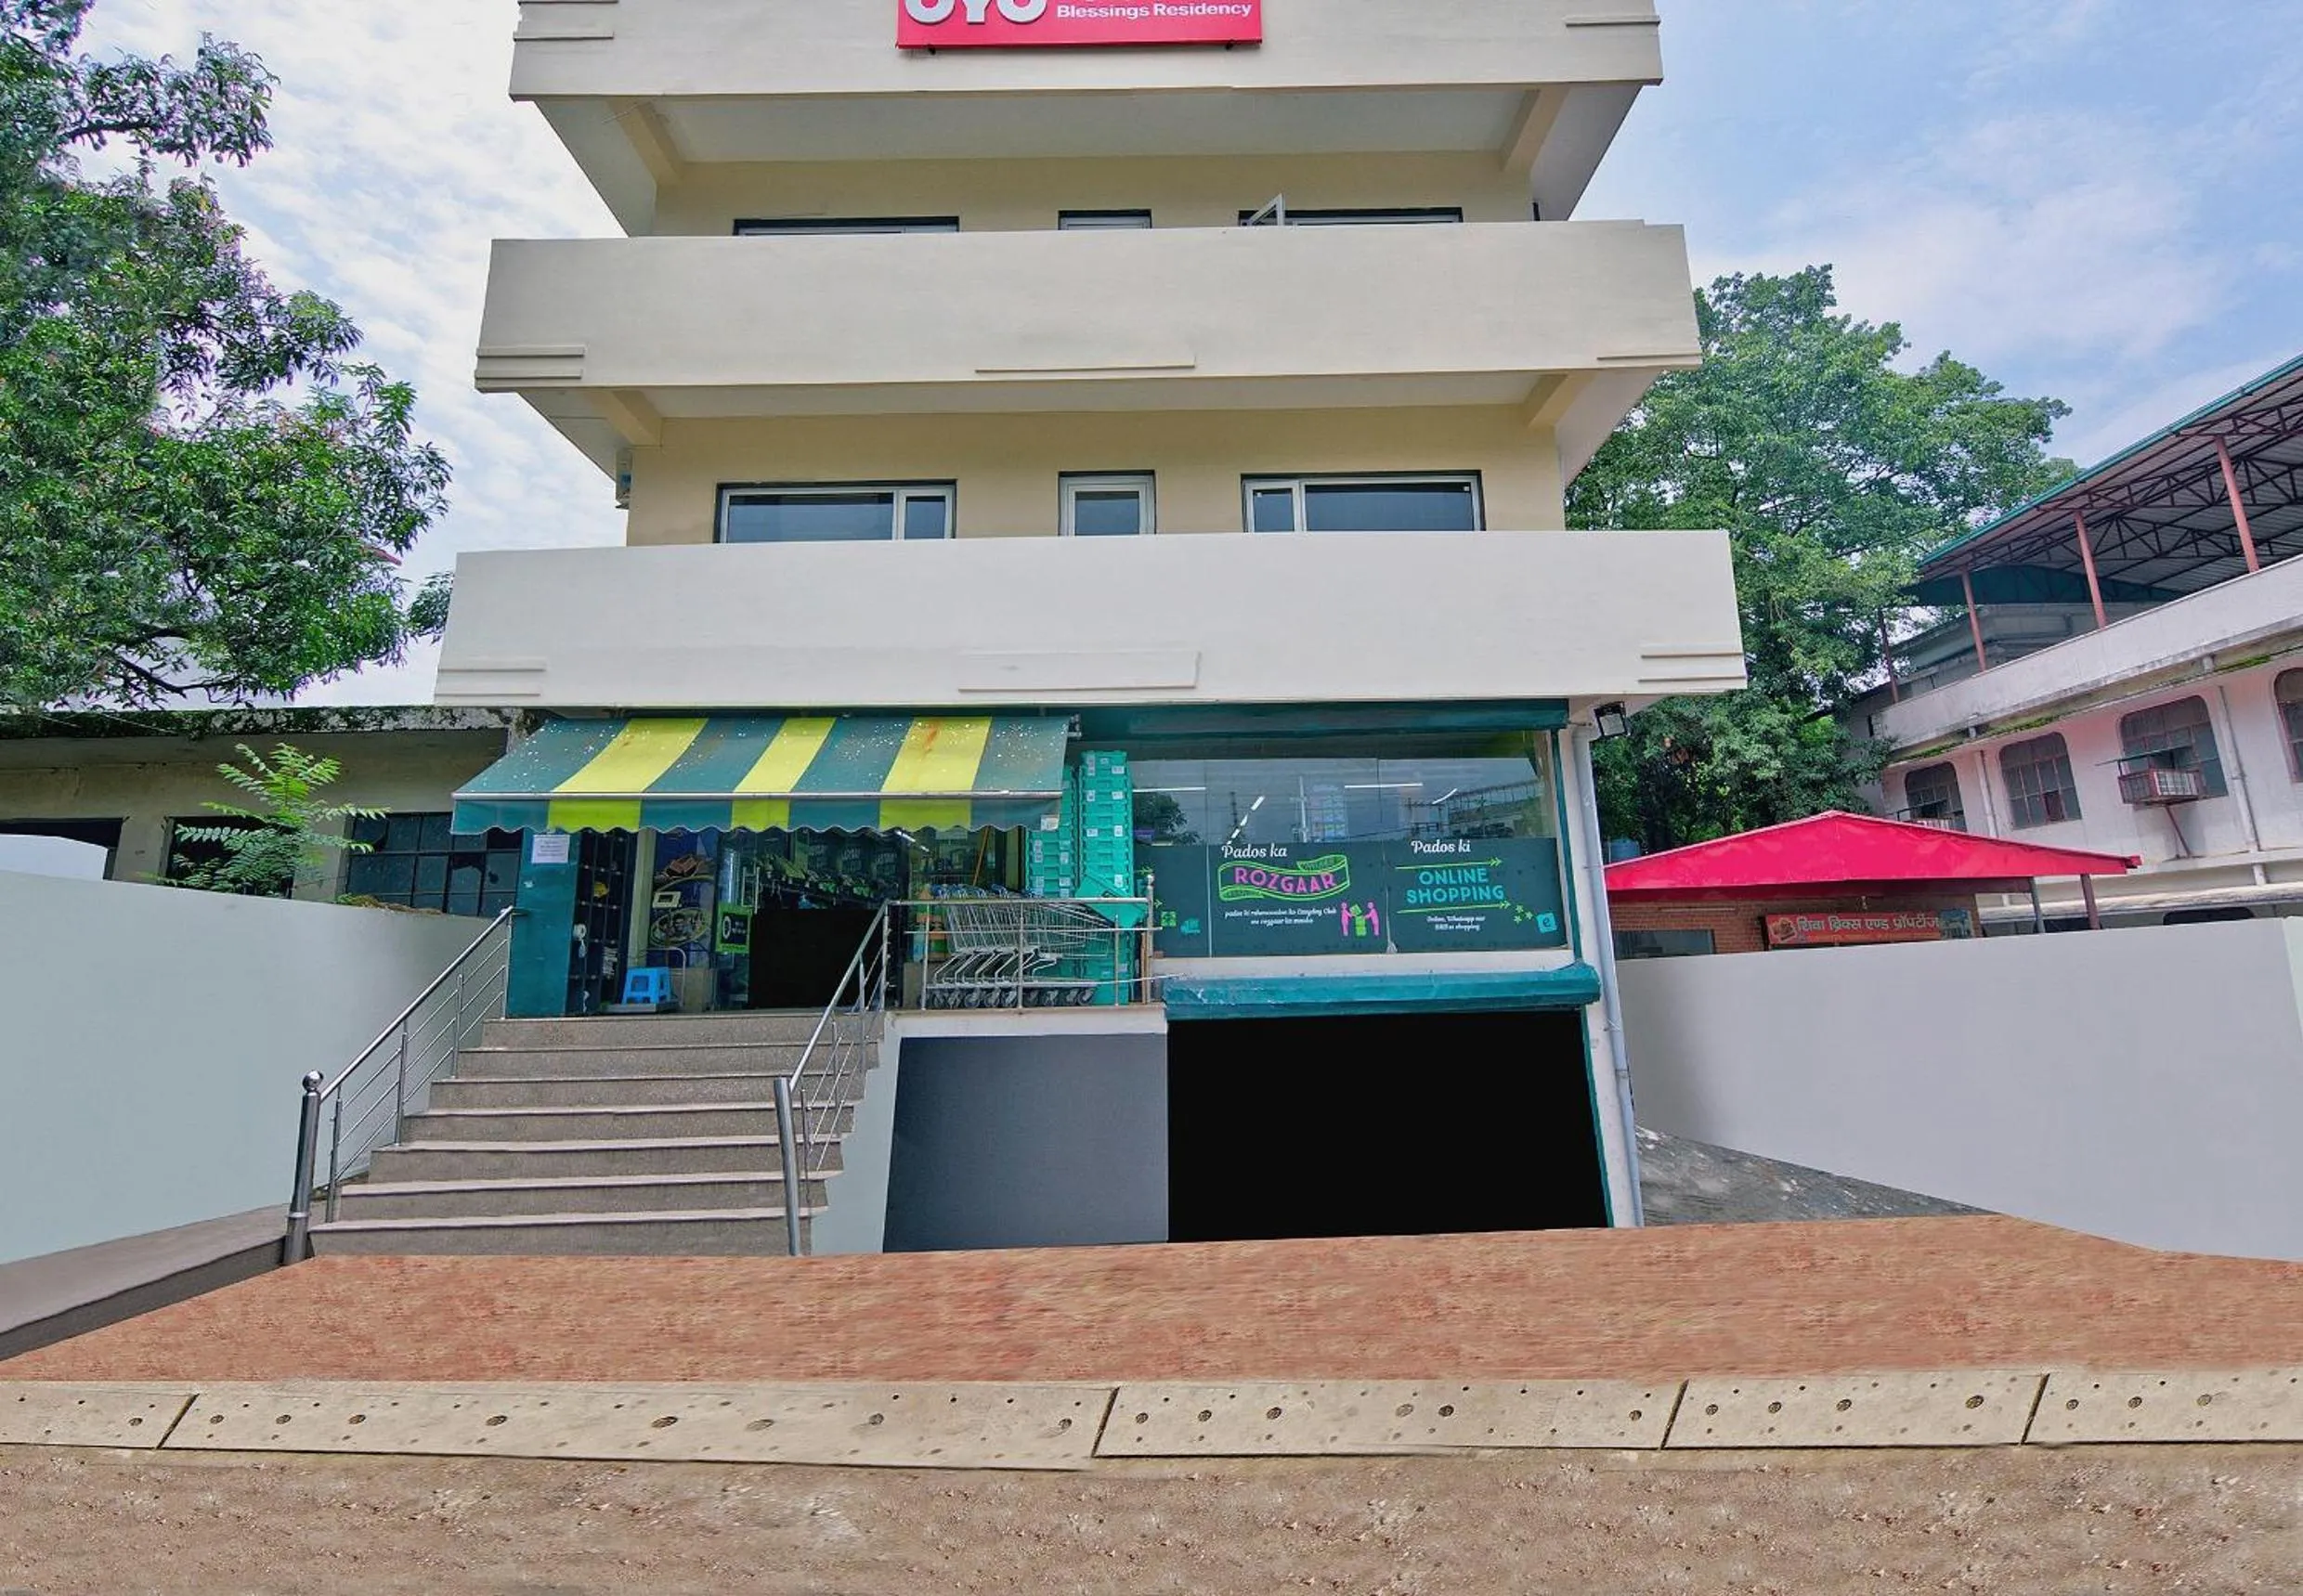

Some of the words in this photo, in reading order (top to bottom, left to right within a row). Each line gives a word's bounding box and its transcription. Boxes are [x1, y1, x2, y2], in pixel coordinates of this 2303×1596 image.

[1057, 5, 1150, 19] Blessings
[1152, 3, 1252, 17] Residency
[1221, 844, 1267, 858] Pados
[1269, 842, 1288, 857] ka
[1411, 839, 1455, 853] Pados
[1458, 839, 1472, 852] ki
[1234, 867, 1335, 893] ROZGAAR
[1419, 868, 1489, 884] ONLINE
[1407, 885, 1504, 903] SHOPPING
